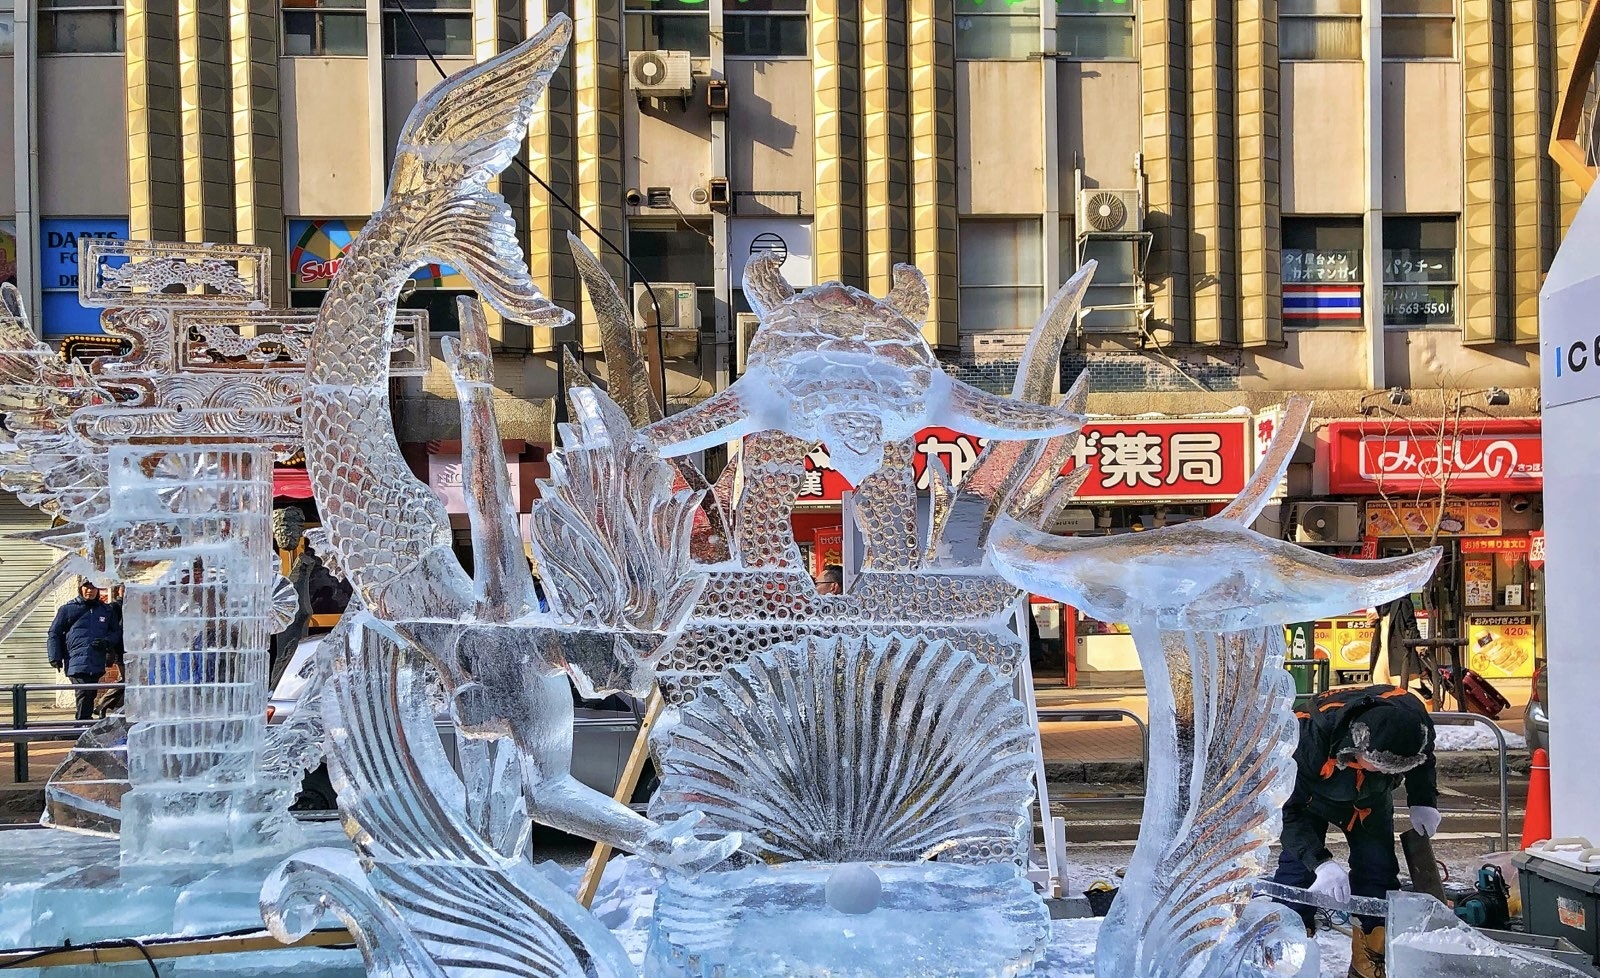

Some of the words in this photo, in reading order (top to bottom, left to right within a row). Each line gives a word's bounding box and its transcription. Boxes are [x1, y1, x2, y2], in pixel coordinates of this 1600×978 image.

[1286, 253, 1347, 265] タイ屋台メシ
[1292, 266, 1358, 279] カオマンガイ
[1385, 259, 1443, 275] パクチー
[1556, 335, 1600, 377] IC
[1377, 440, 1519, 479] みよしの
[1464, 540, 1526, 549] お持ち帰り注文口
[1475, 617, 1526, 625] おみやげぎょうざ
